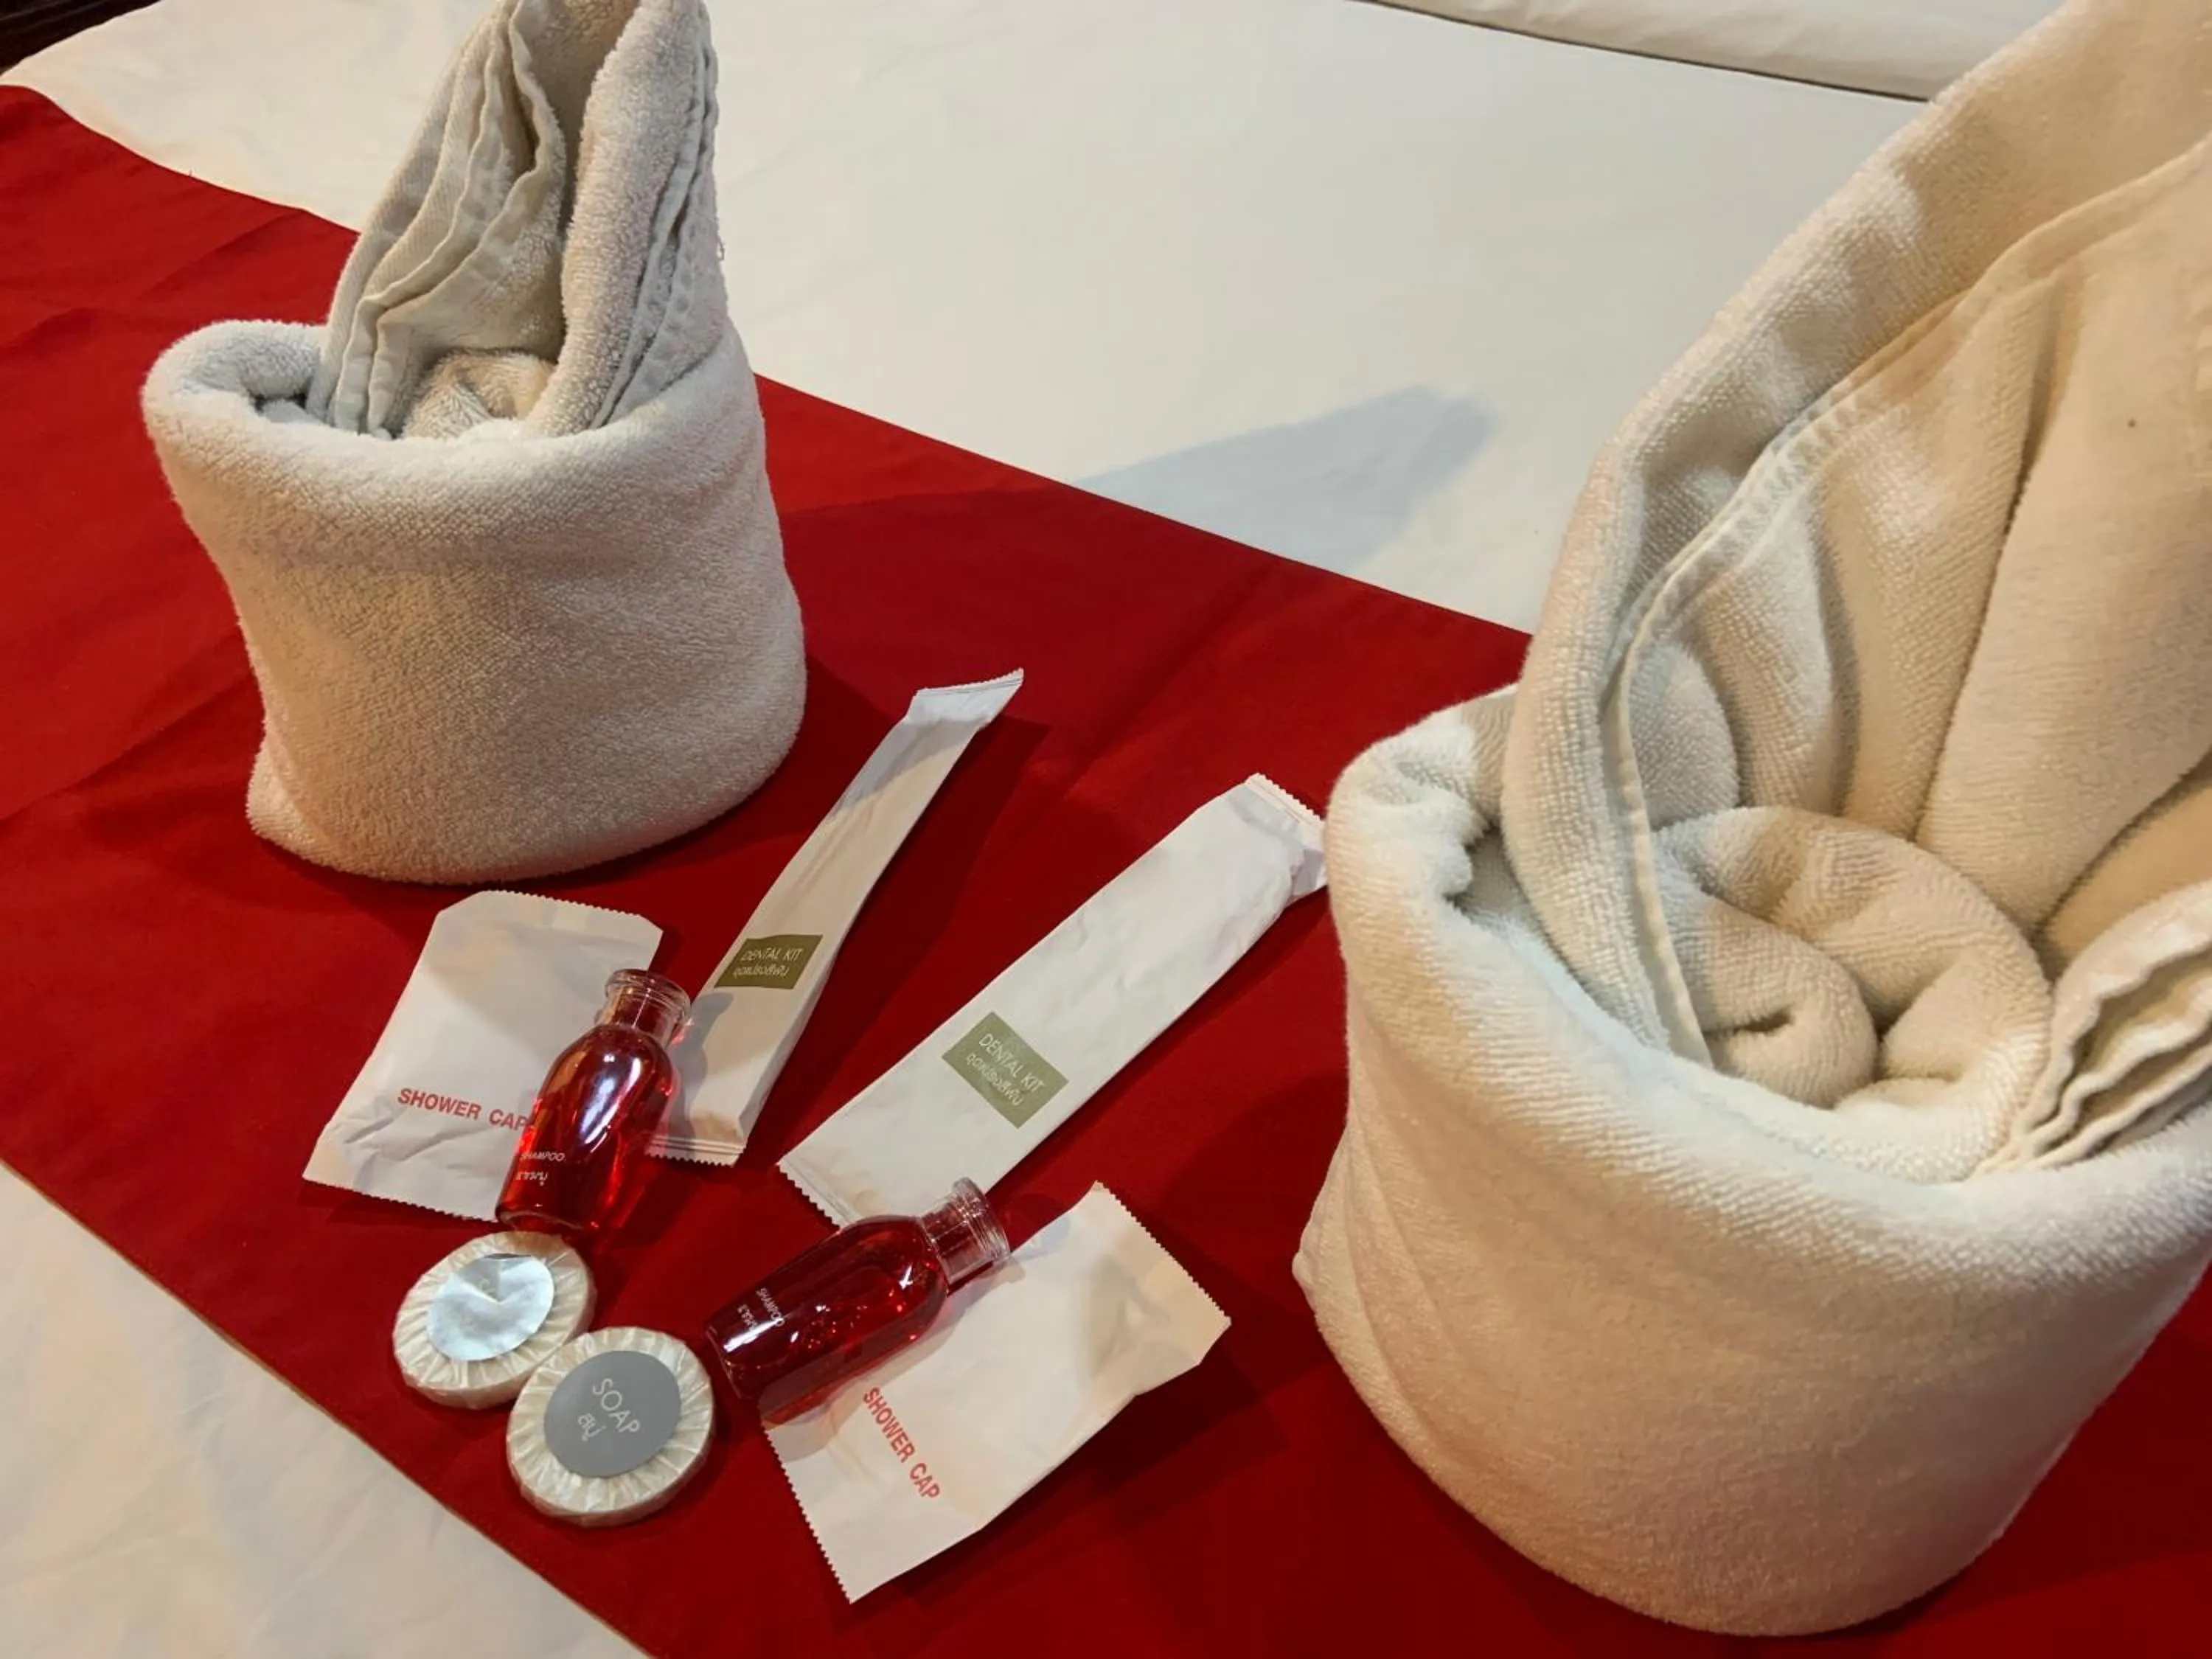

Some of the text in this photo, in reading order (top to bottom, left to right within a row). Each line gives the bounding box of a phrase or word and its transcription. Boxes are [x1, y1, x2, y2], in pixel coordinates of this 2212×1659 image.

[740, 947, 804, 961] DENTAL KIT
[978, 1033, 1046, 1093] DENTAL KIT
[397, 1088, 530, 1131] SHOWER CAP
[518, 1150, 566, 1162] SHAMPOO
[756, 1287, 785, 1326] SHAMPOO
[592, 1377, 641, 1433] SOAP
[863, 1387, 941, 1498] SHOWER CAP
